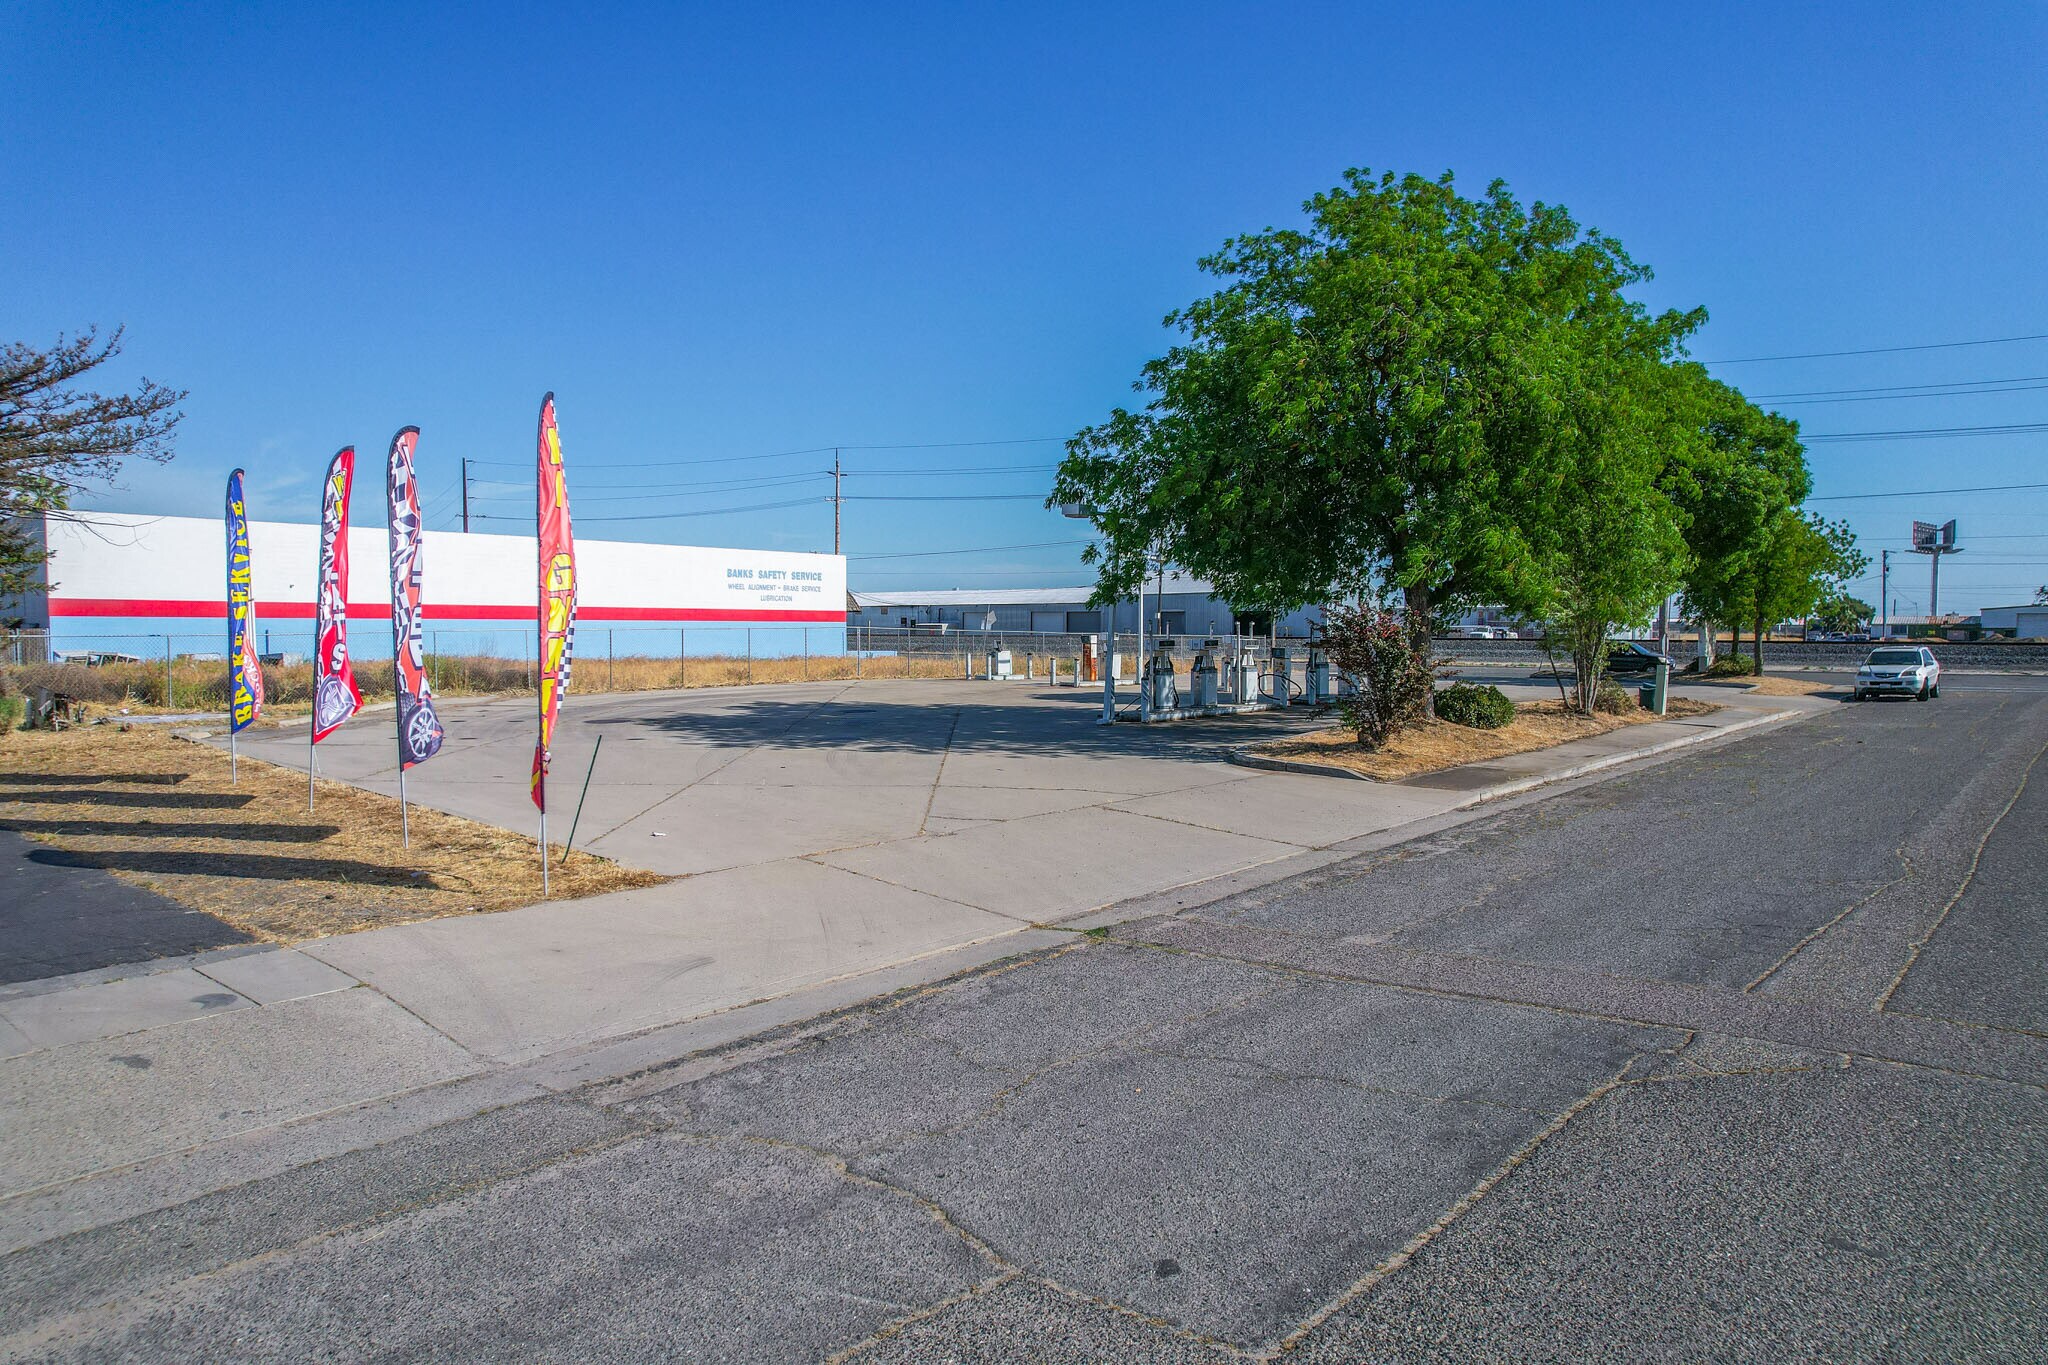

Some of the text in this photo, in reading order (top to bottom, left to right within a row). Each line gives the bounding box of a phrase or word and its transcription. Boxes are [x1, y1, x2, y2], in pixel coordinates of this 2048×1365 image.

[727, 568, 822, 581] BANKS SAFETY SERVICE
[783, 584, 799, 592] BRAKE
[760, 594, 792, 602] LUBRICATION
[233, 631, 252, 725] BRAKE
